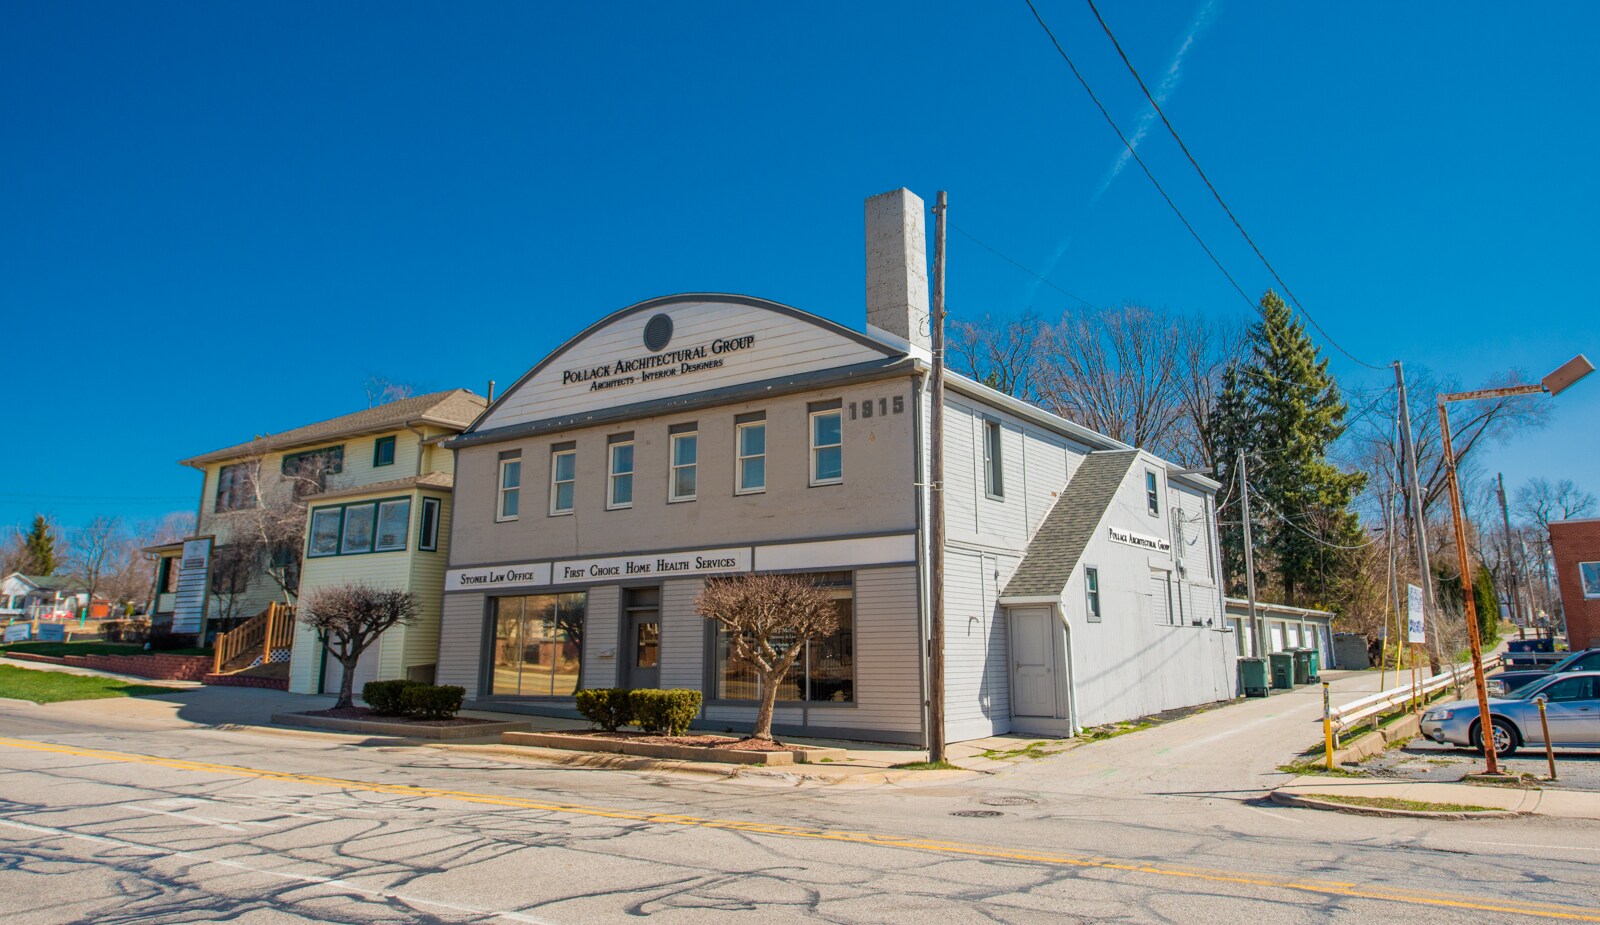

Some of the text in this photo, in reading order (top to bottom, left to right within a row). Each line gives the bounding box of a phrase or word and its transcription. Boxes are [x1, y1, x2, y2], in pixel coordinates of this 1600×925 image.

[563, 335, 755, 384] POLLACK ARCHITECTURAL GROUP
[589, 358, 724, 392] ARCHITECTS INTERIOR DESIGNERS
[848, 395, 904, 420] 1915
[460, 569, 534, 585] STONER LAW OFFICE
[564, 556, 736, 579] FIRST CHOICE HOME HEALTH SERVICES
